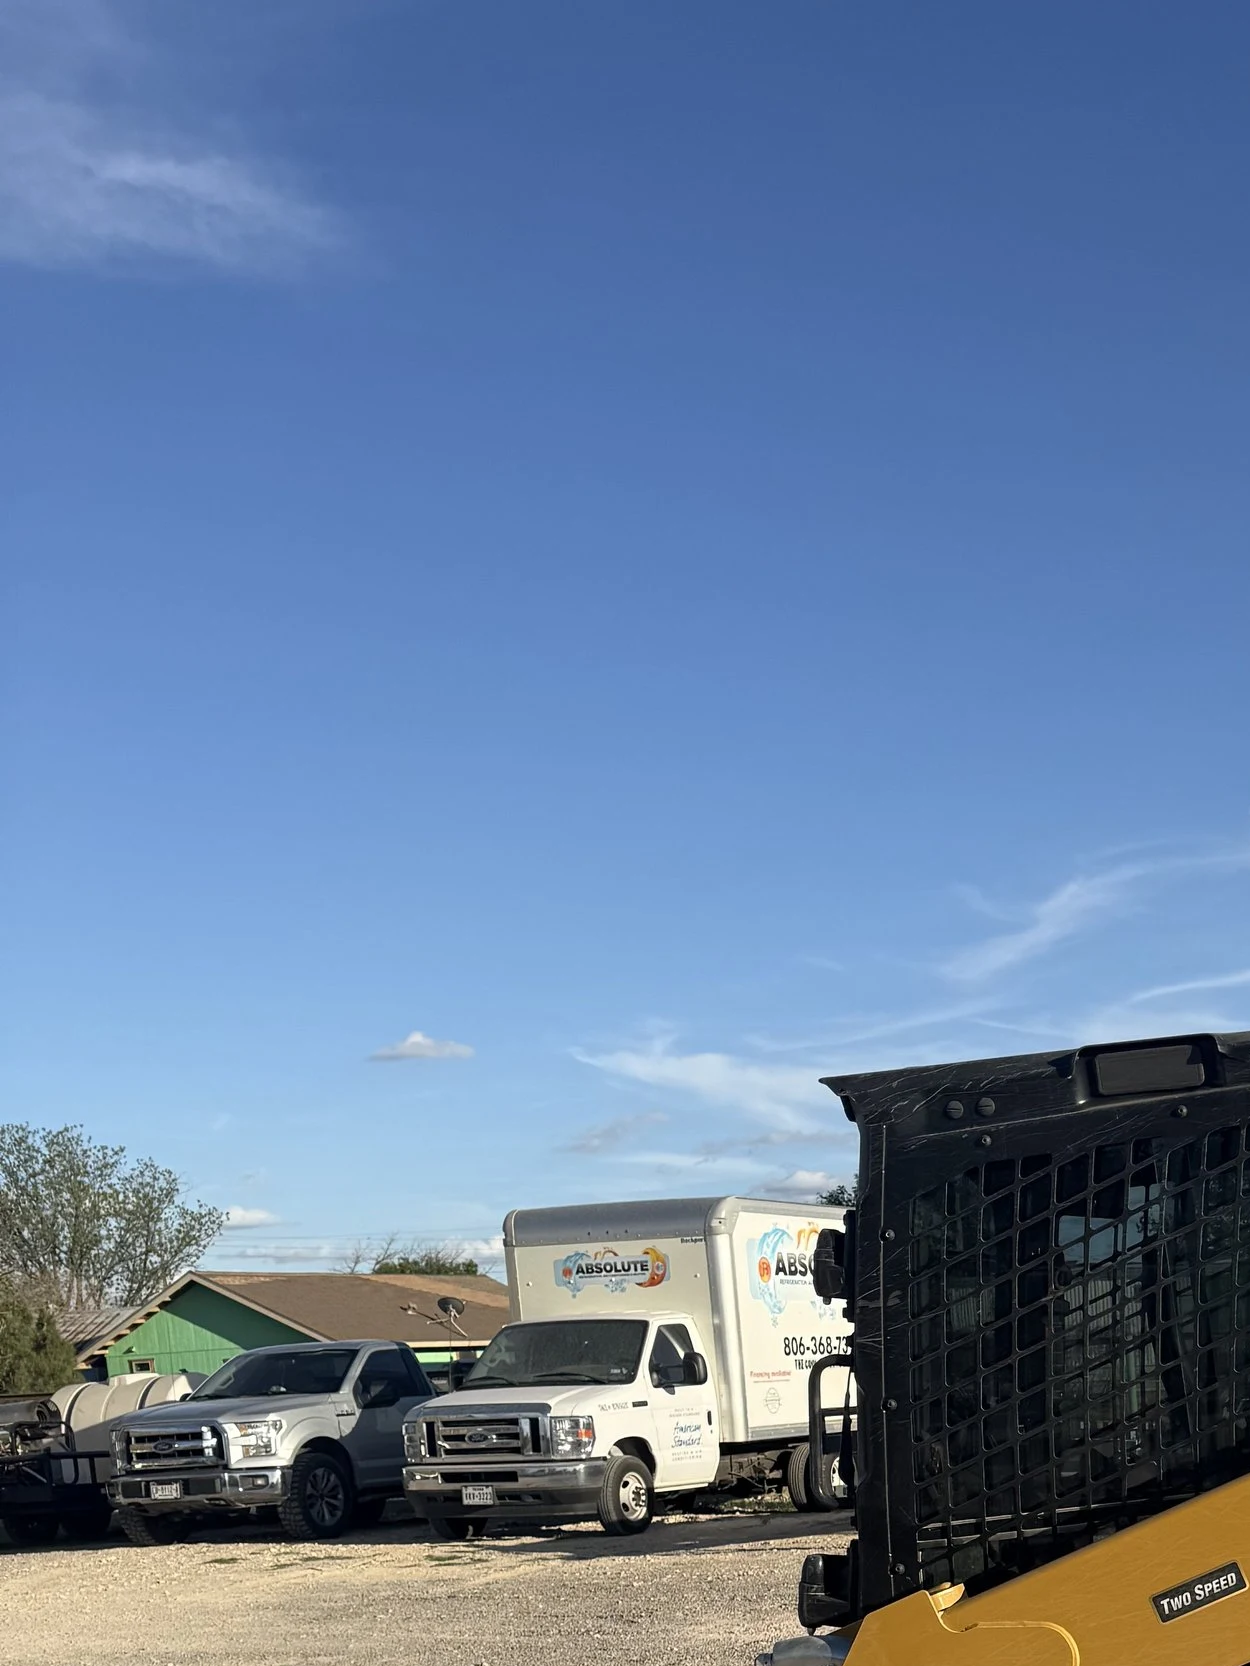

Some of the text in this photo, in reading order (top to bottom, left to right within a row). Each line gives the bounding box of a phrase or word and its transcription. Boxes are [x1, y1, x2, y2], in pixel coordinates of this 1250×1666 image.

[575, 1260, 649, 1275] ABSOLUTE
[775, 1252, 815, 1276] ABS
[783, 1336, 848, 1356] 806-368-73
[1160, 1572, 1237, 1615] TWO SPEED
